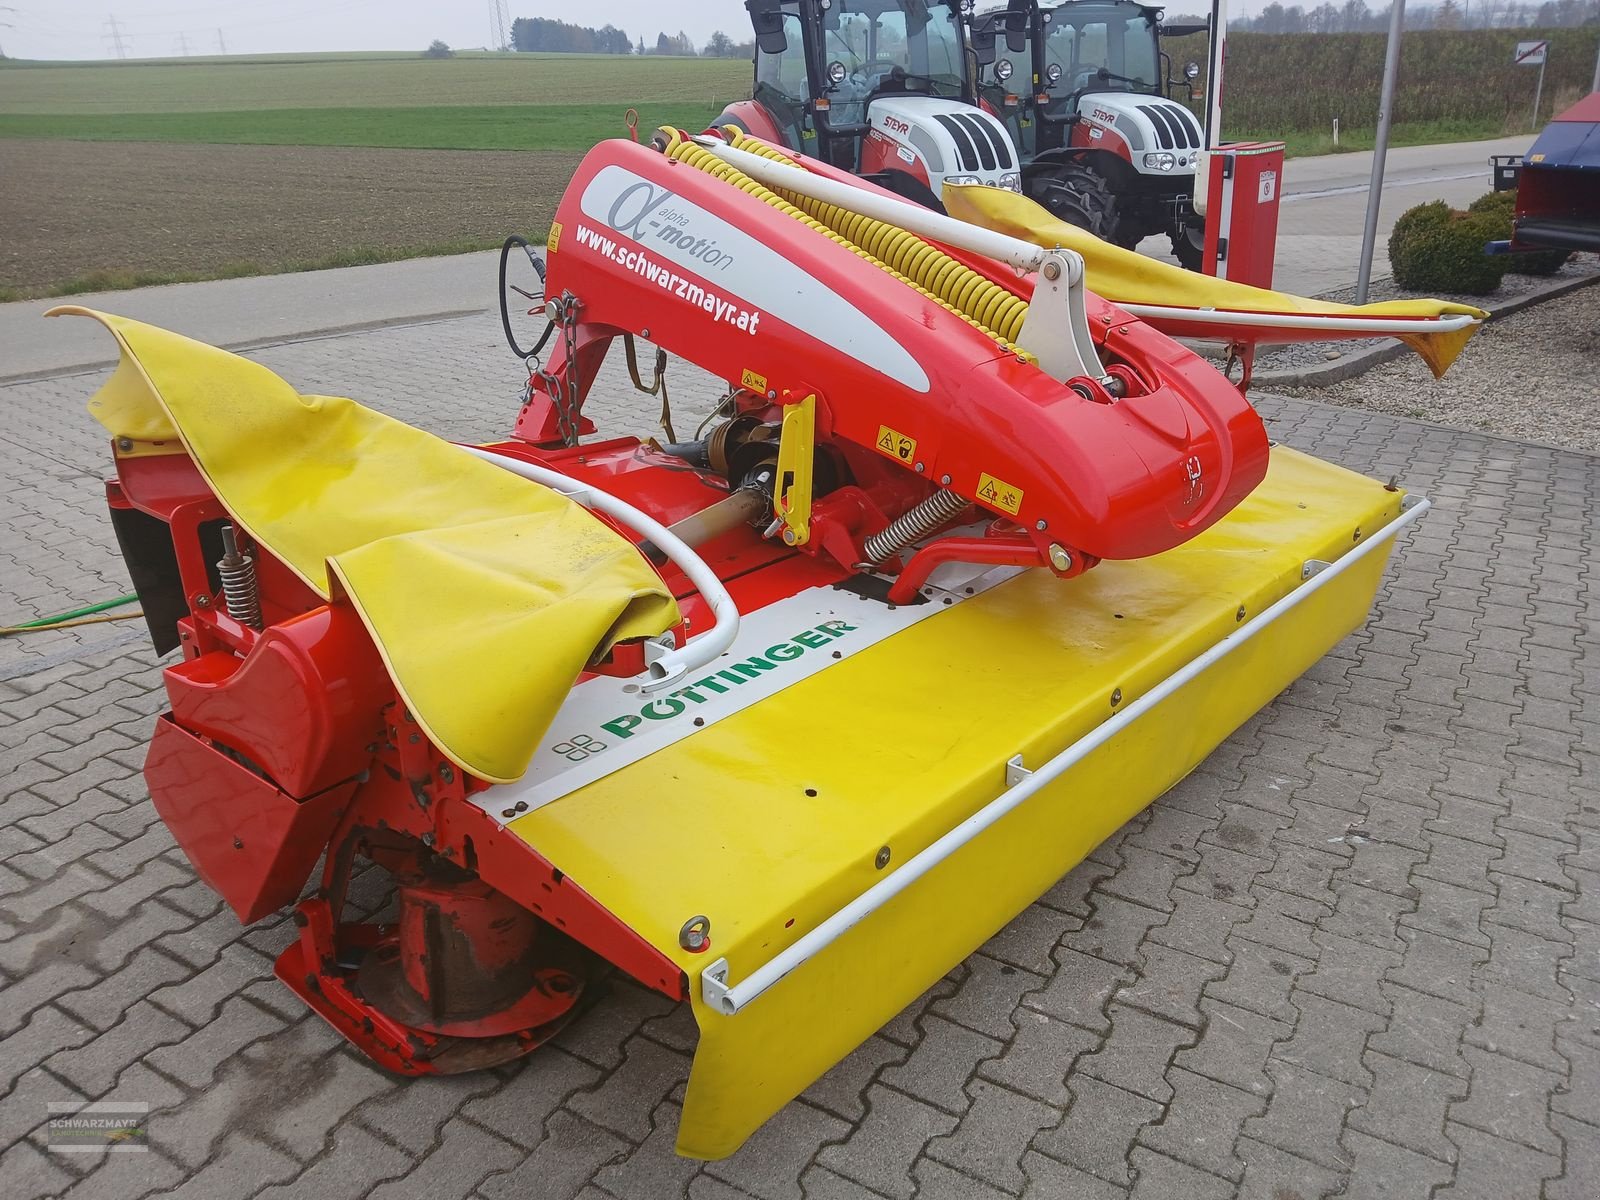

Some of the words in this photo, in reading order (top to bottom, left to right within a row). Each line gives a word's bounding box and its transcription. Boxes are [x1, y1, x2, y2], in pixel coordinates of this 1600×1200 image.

[884, 116, 909, 135] STEYR
[1092, 109, 1115, 124] STEYR
[658, 208, 690, 226] alpha
[576, 224, 760, 335] www.schwarzmayr.at
[600, 620, 858, 739] PÖTTINGER
